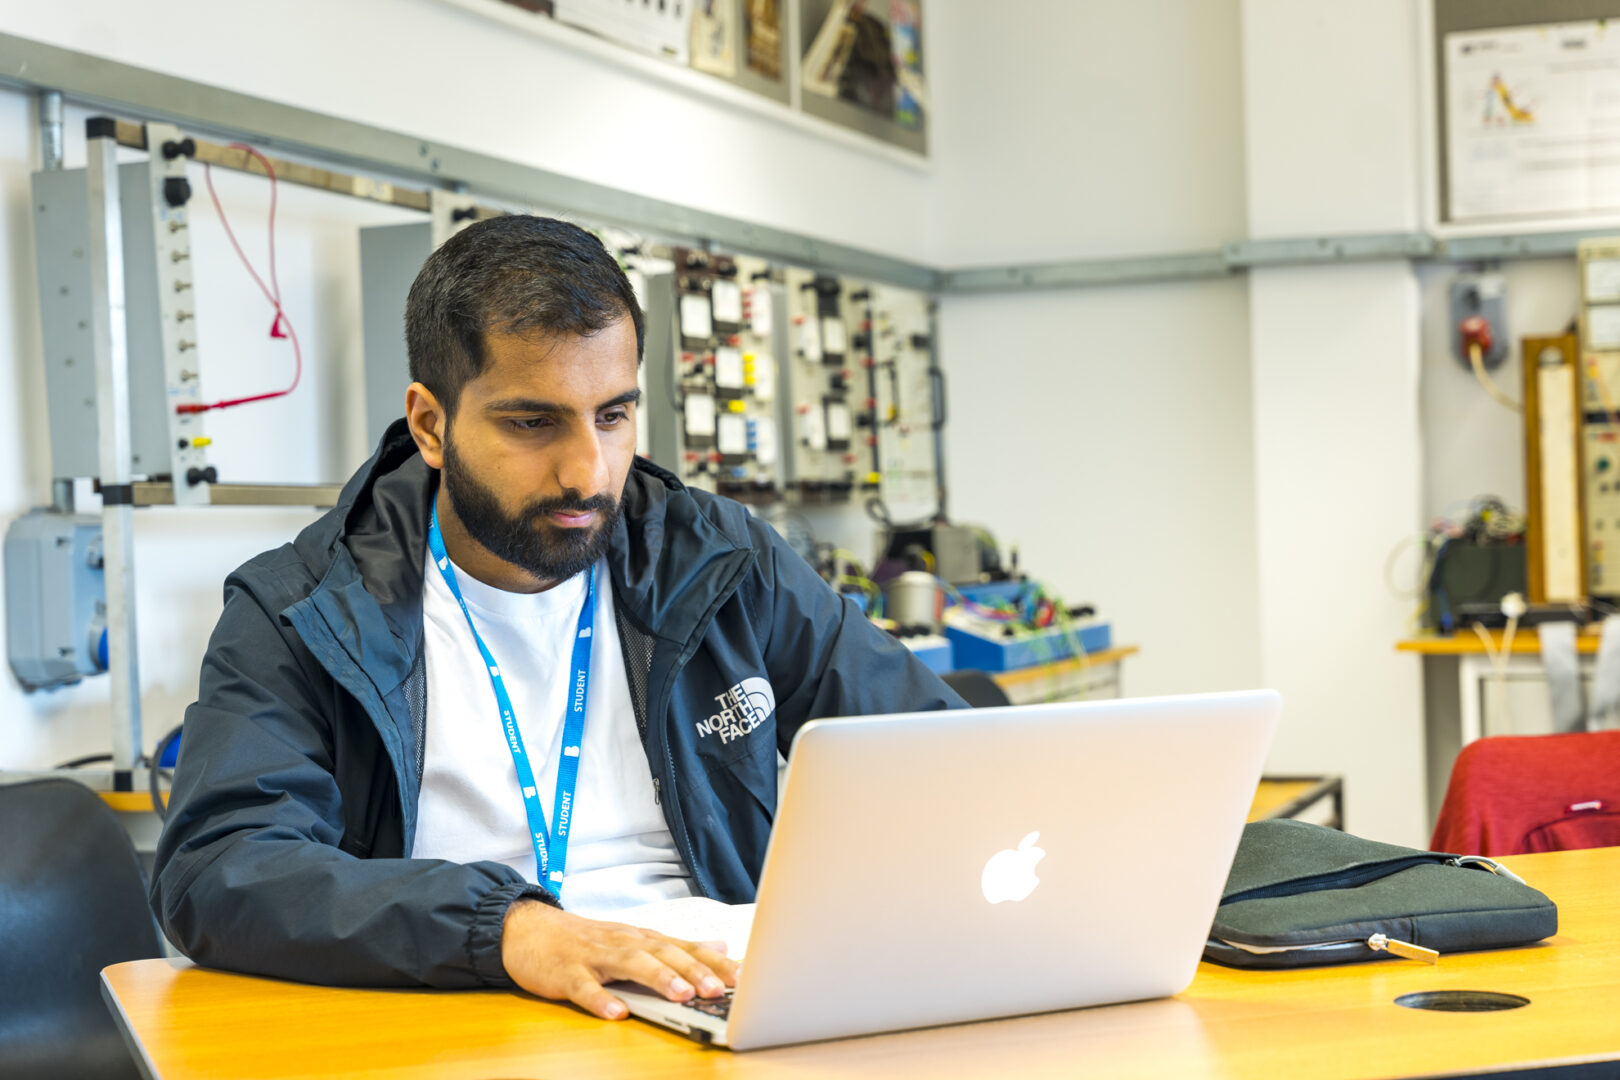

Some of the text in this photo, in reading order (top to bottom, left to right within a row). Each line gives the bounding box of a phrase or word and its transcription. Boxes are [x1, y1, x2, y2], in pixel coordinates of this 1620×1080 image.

[574, 670, 586, 712] STUDENT
[714, 683, 746, 709] THE
[504, 710, 521, 754] STUDENT
[695, 698, 753, 738] NORTH
[719, 711, 760, 744] FACE
[558, 791, 571, 836] STUDENT
